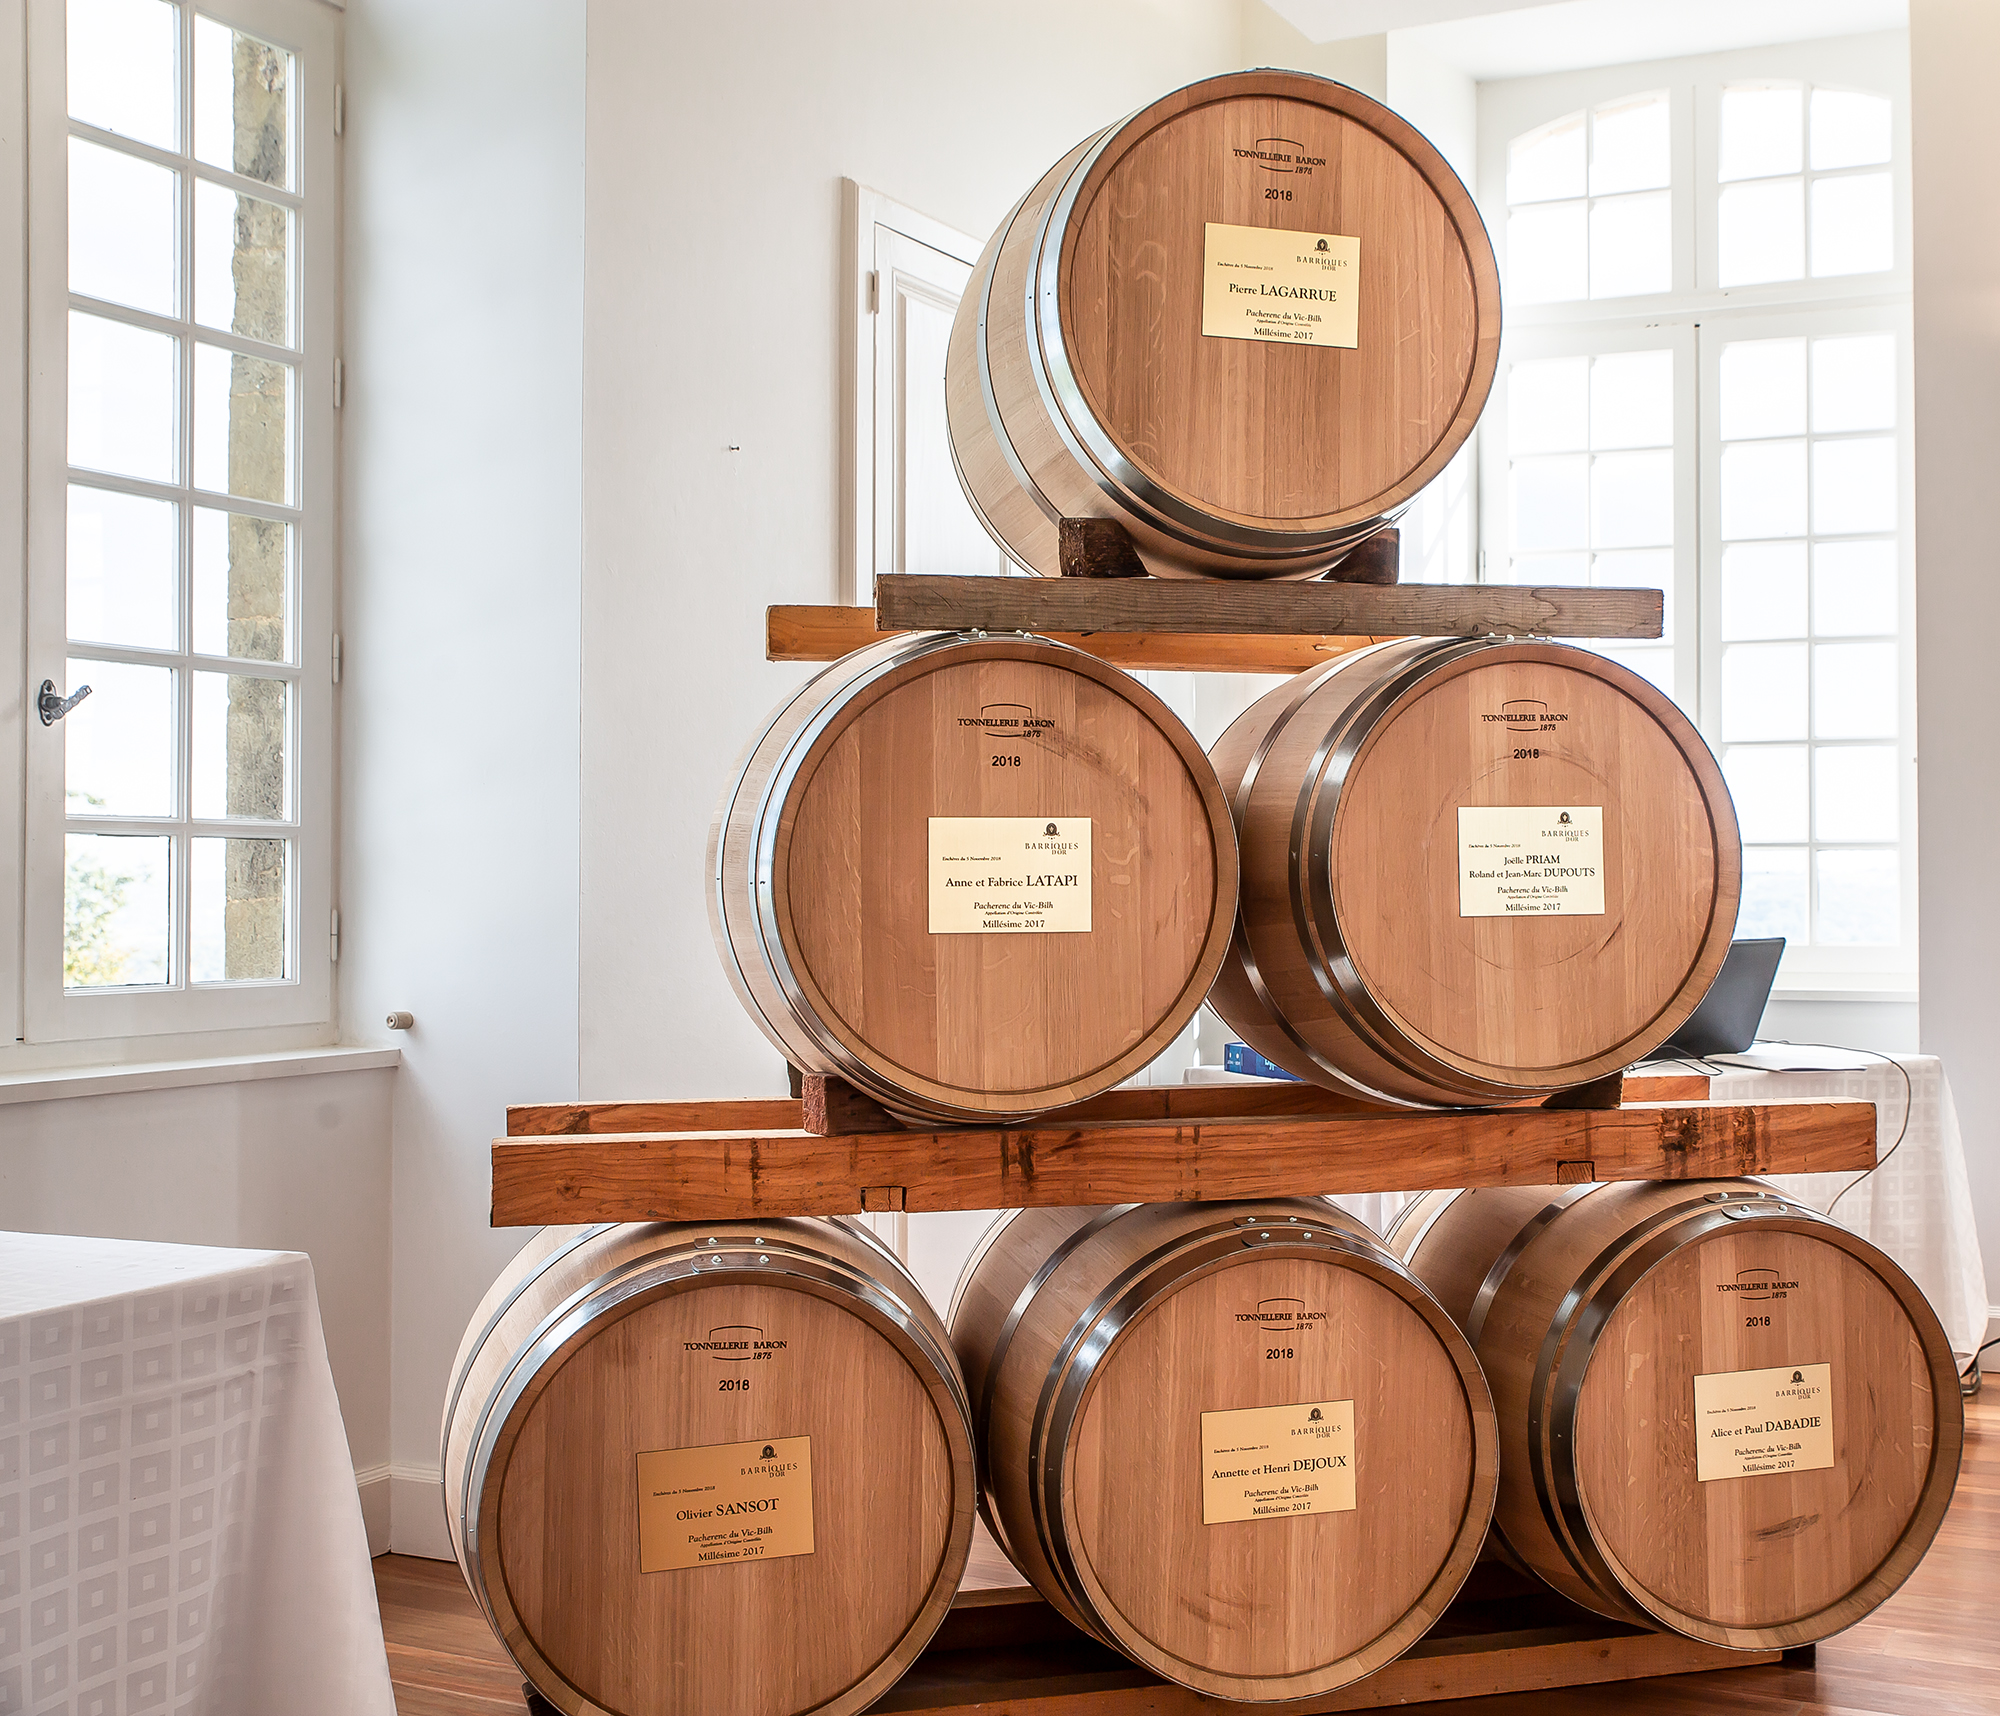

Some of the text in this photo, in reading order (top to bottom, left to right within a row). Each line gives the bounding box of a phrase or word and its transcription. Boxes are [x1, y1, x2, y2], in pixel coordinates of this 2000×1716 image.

[1233, 149, 1326, 166] TONNELLERIE BARON
[1265, 188, 1292, 201] 2018
[1229, 283, 1337, 301] Pierre LAGARRUE
[1246, 309, 1281, 319] Pacherenc
[1294, 313, 1322, 322] Vic-Bilh
[1254, 328, 1313, 340] Millésime 2017
[957, 718, 1018, 726] TONNELLERIE
[1514, 749, 1539, 759] 2018
[992, 756, 1020, 766] 2018
[1504, 855, 1560, 865] Joëlle PRIAM
[1505, 870, 1542, 879] Jean-Marc
[1544, 868, 1595, 877] DUPOUTS
[946, 875, 1078, 887] Anne et Fabrice LATAPI
[974, 902, 1010, 910] Pacherenc
[983, 920, 1045, 928] Millésime 2017
[1717, 1281, 1799, 1291] TONNELLERIE BARON
[1235, 1313, 1292, 1321] TONNELLERIE
[1746, 1316, 1770, 1327] 2018
[684, 1341, 787, 1350] TONNELLERIE BARON
[1266, 1348, 1293, 1359] 2018
[719, 1380, 750, 1391] 2018
[1711, 1429, 1732, 1437] Alice
[1745, 1424, 1763, 1434] Paul
[1765, 1417, 1821, 1432] DABADIE
[1735, 1448, 1765, 1456] Pacherenc
[1776, 1443, 1801, 1451] Vic-Bilh
[1212, 1456, 1346, 1479] Annette et Henri DEJOUX
[1743, 1460, 1795, 1472] Millésime 2017
[1291, 1484, 1319, 1493] Vic-Bilh
[677, 1498, 779, 1521] Olivier SANSOT
[1253, 1502, 1311, 1515] Millésime 2017
[688, 1534, 727, 1543] Pacherenc
[741, 1527, 773, 1536] Vic-Bilh
[698, 1546, 764, 1561] Millésime 2017
